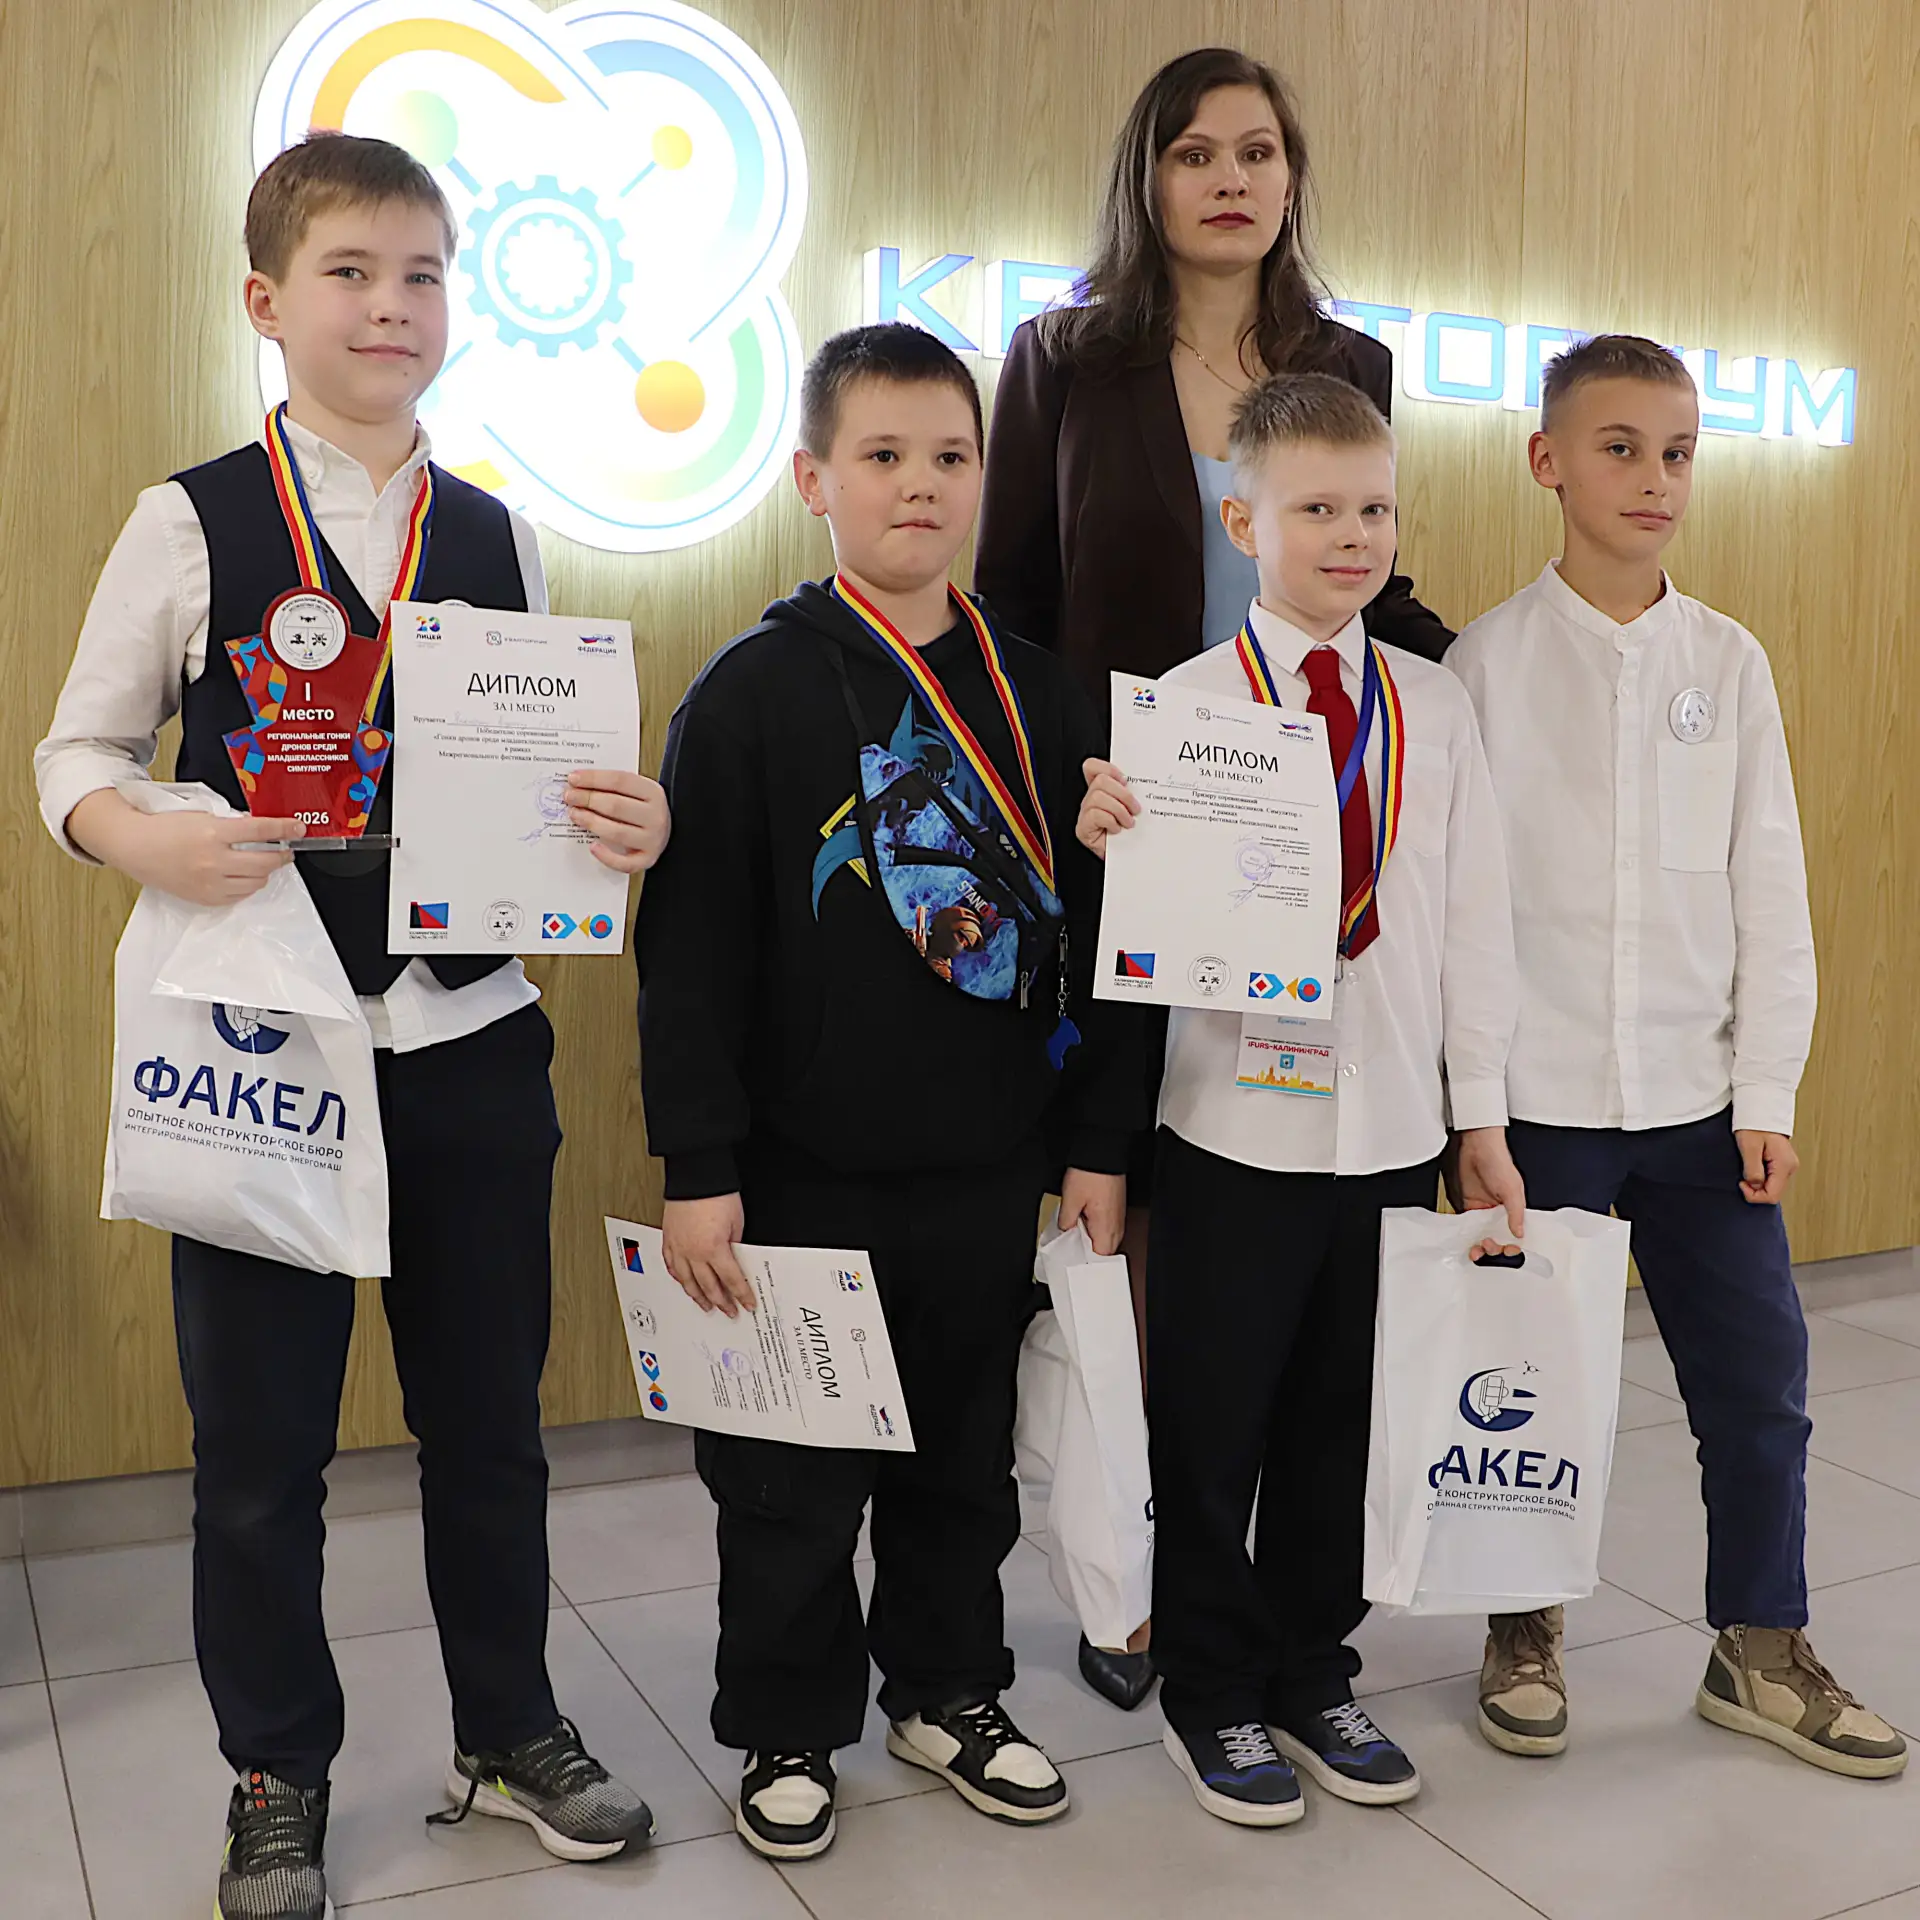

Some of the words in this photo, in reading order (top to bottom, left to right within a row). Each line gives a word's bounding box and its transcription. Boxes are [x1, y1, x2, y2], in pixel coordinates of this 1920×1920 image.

[578, 646, 617, 654] ФЕДЕРАЦИЯ
[467, 672, 576, 698] ДИПЛОМ
[493, 702, 507, 711] ЗА
[516, 703, 555, 714] МЕСТО
[1278, 730, 1314, 741] ФЕДЕРАЦИЯ
[281, 744, 311, 752] ДРОНОВ
[313, 744, 337, 752] СРЕДИ
[1178, 741, 1279, 773] ДИПЛОМ
[267, 754, 349, 762] МЛАДШЕКЛАССНИКОВ
[1199, 768, 1212, 777] ЗА
[1214, 770, 1225, 779] III
[1227, 772, 1263, 784] МЕСТО
[294, 811, 329, 825] 2026
[134, 1056, 346, 1141] ФАКЕЛ
[127, 1107, 185, 1130] ОПЫТНОЕ
[187, 1120, 305, 1153] КОНСТРУКТОРСКОЕ
[307, 1144, 343, 1159] БЮРО
[125, 1123, 212, 1147] ИНТЕГРИРОВАННАЯ
[213, 1142, 266, 1158] СТРУКТУРА
[268, 1152, 288, 1162] НПО
[289, 1155, 342, 1172] ЭНЕРГОМАШ
[793, 1325, 802, 1337] ЗА
[799, 1347, 812, 1380] МЕСТО
[799, 1307, 841, 1398] ДИПЛОМ
[1444, 1491, 1545, 1504] КОНСТРУКТОРСКОЕ
[1547, 1497, 1576, 1512] БЮРО
[1468, 1503, 1511, 1512] СТРУКТУРА
[1529, 1507, 1575, 1521] ЭНЕРГОМАШ
